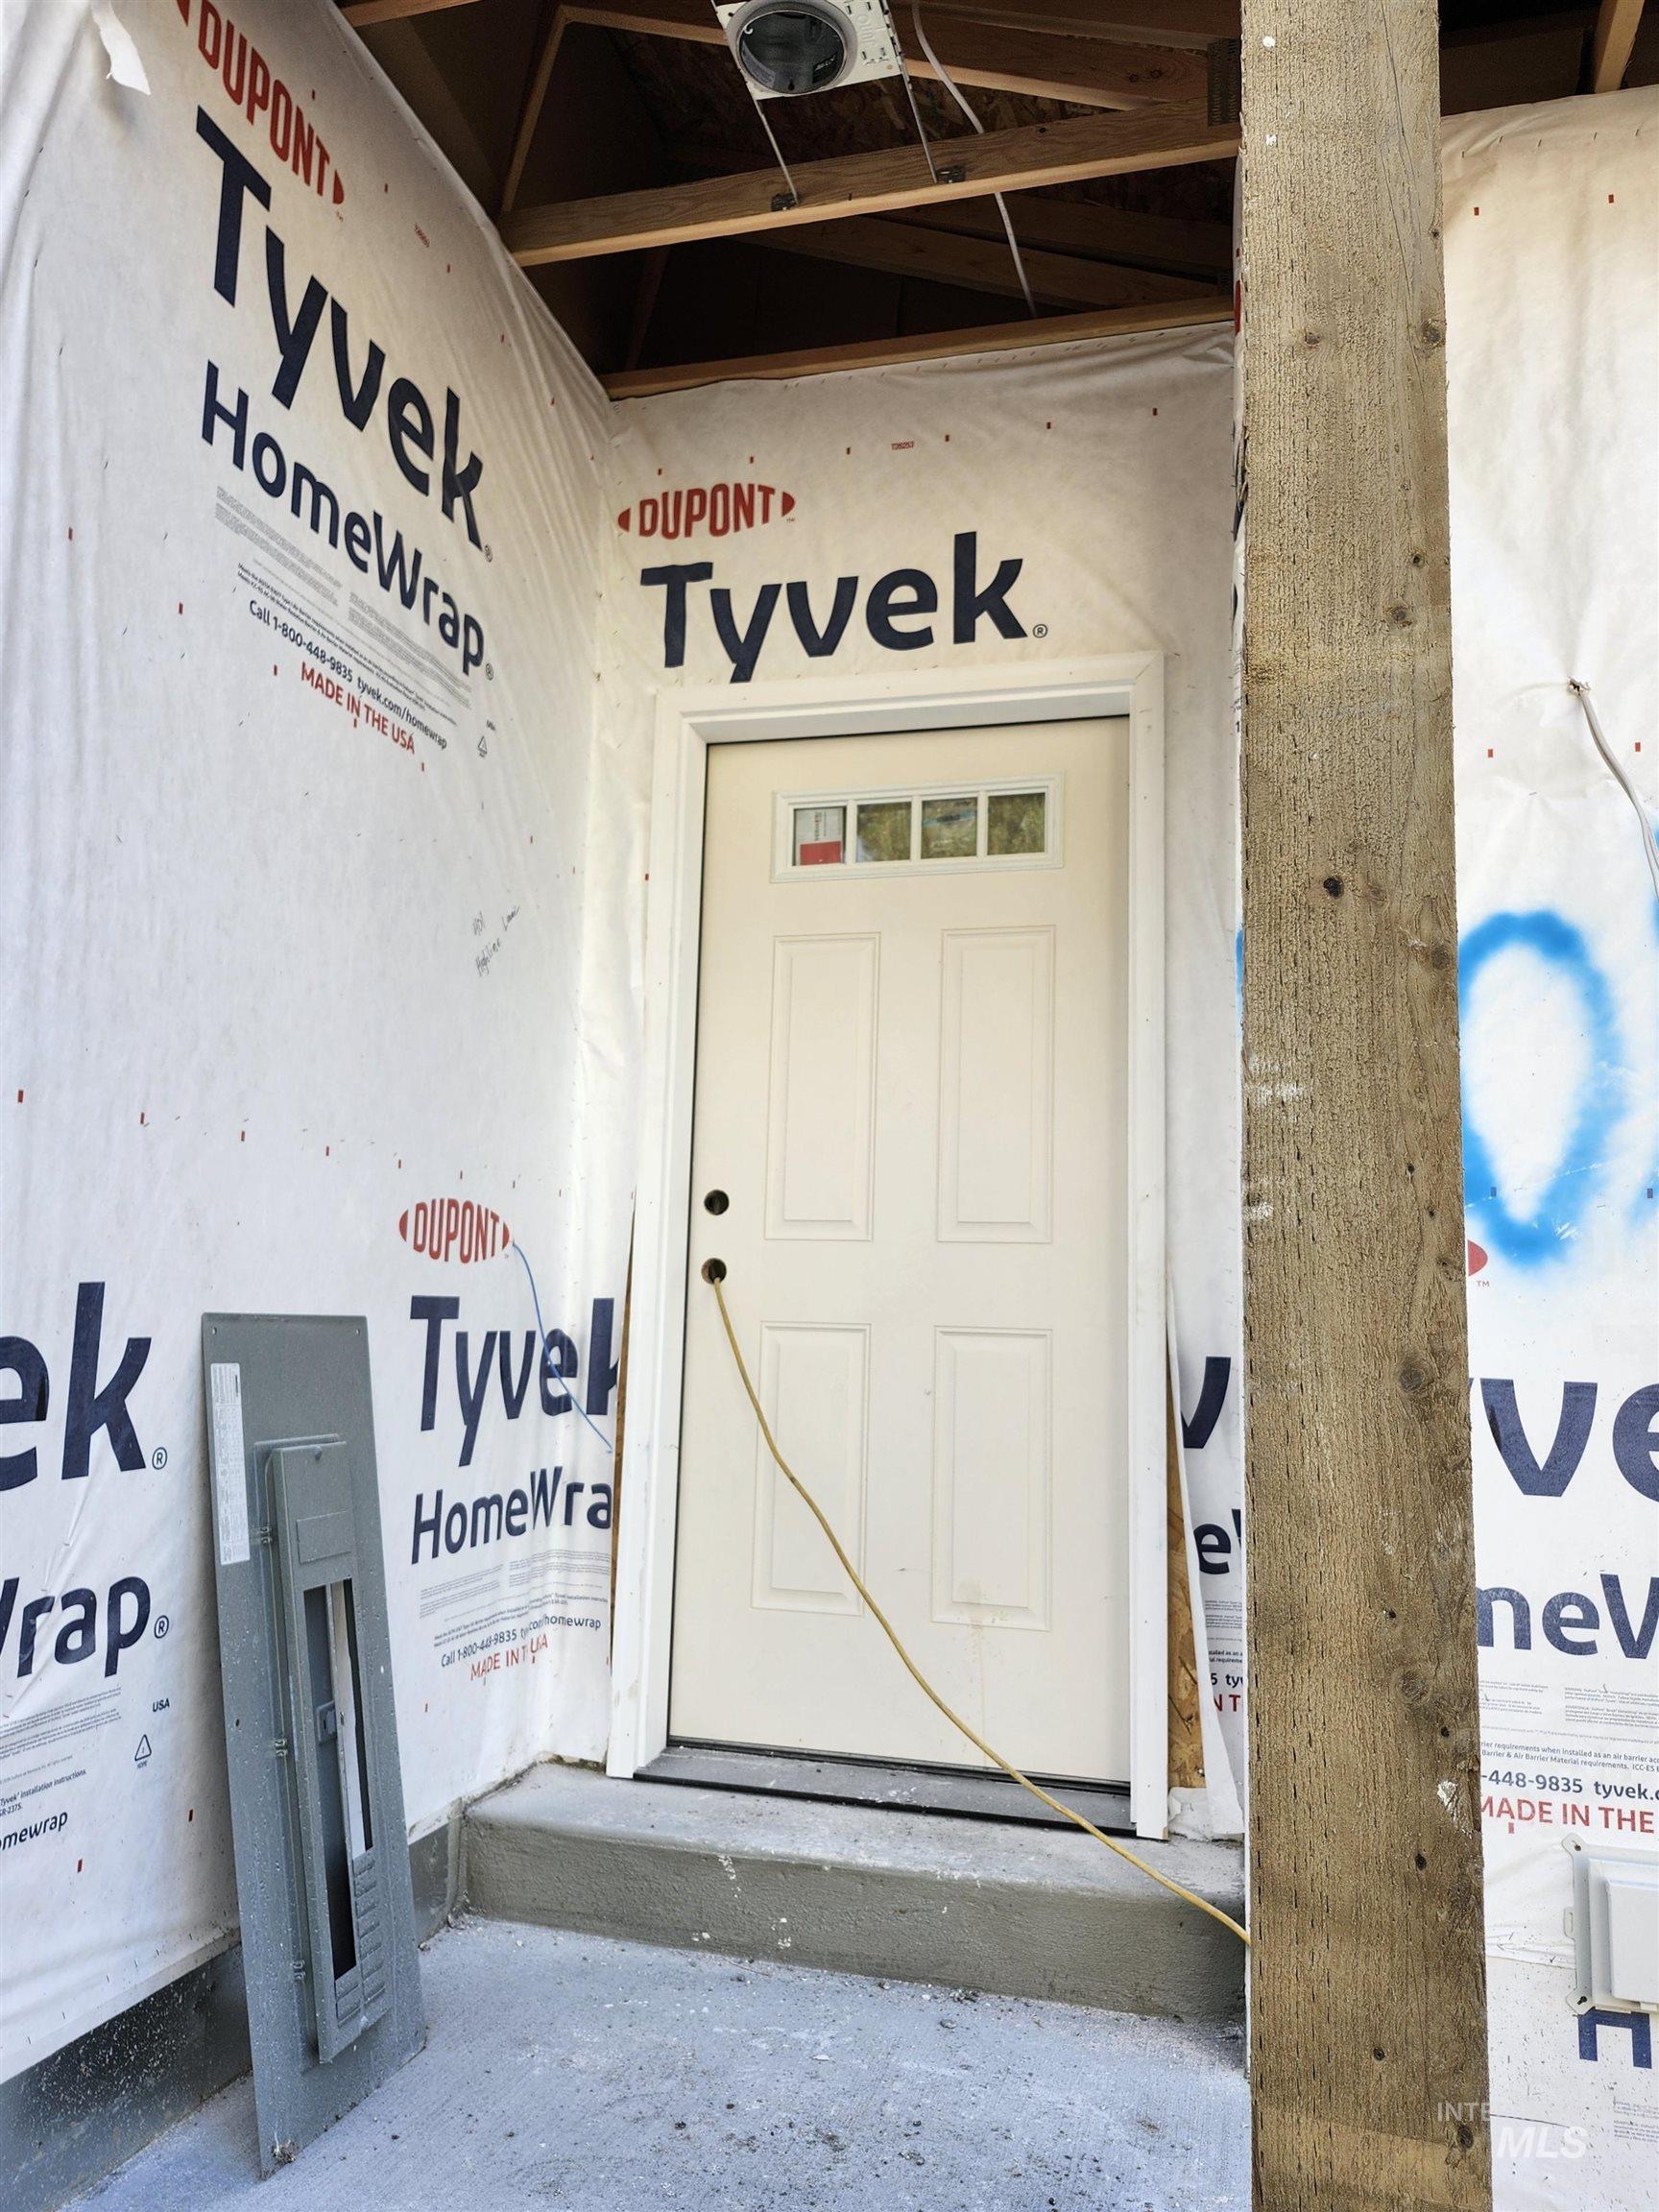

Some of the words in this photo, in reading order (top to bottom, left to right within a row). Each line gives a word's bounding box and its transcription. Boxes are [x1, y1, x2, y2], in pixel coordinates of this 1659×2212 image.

[198, 0, 330, 197] DUPONT
[638, 483, 776, 540] DUPONT
[250, 599, 271, 626] Call
[301, 661, 344, 706] MADE
[347, 692, 361, 718] IN
[364, 704, 389, 736] THE
[392, 723, 415, 755] USA
[413, 1197, 500, 1264] DUPONT
[411, 1467, 613, 1565] HomeWra
[470, 1652, 500, 1681] MADE
[506, 1647, 519, 1668] IN
[153, 1697, 170, 1713] USA
[1495, 1743, 1540, 1753] requirements
[1541, 1746, 1561, 1755] when
[1562, 1748, 1593, 1758] installed
[1623, 1754, 1648, 1763] barrier
[1550, 1757, 1579, 1766] Material
[0, 1811, 68, 1851] mewrap
[1562, 1803, 1590, 1826] IN
[1599, 1806, 1654, 1833] THE
